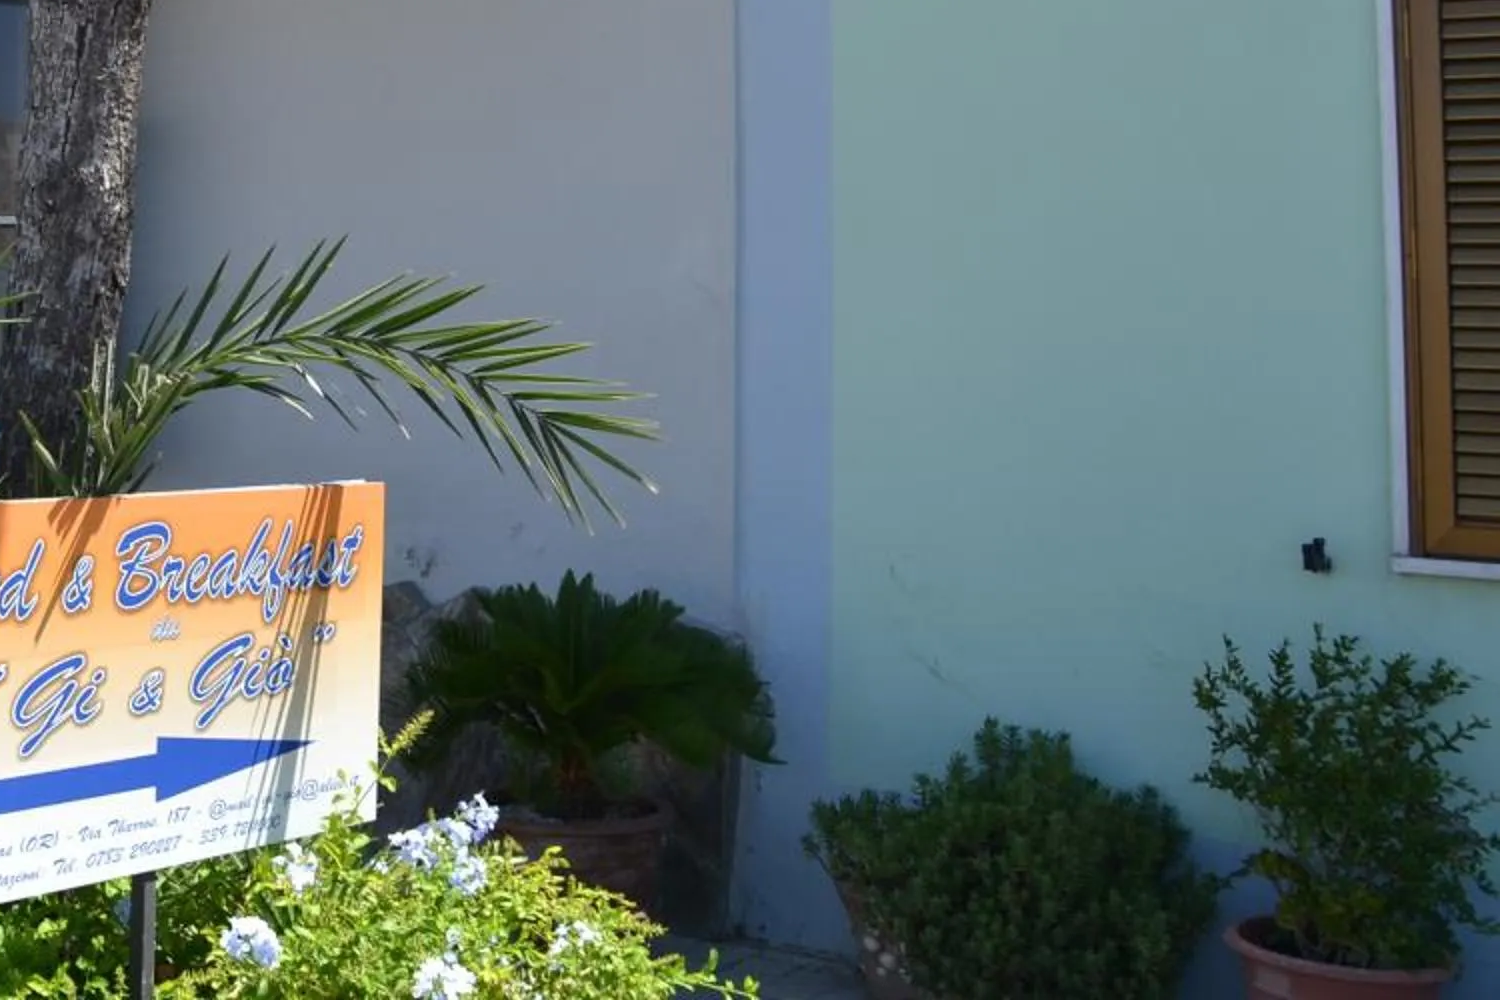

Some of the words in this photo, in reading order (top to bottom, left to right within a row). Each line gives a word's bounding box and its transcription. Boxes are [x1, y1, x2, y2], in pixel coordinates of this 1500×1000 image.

[62, 554, 93, 612] &
[115, 518, 363, 623] Breakfast
[130, 669, 165, 713] &
[20, 830, 59, 852] (OR)
[78, 825, 102, 842] Via
